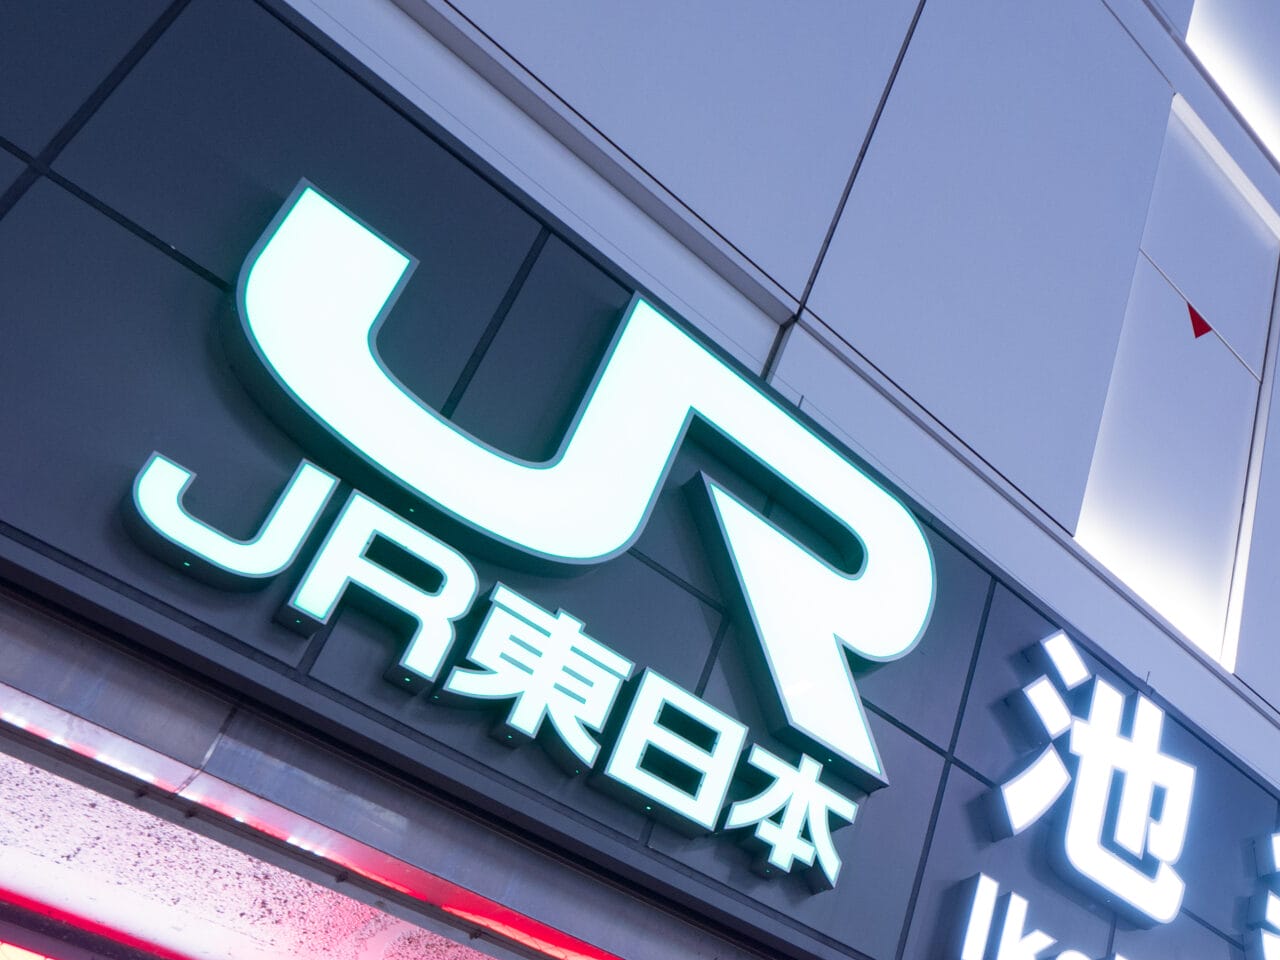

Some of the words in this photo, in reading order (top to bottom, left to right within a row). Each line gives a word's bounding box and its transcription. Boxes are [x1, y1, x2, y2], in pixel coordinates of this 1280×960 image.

[131, 451, 859, 888] JR東日本
[237, 178, 938, 786] JR
